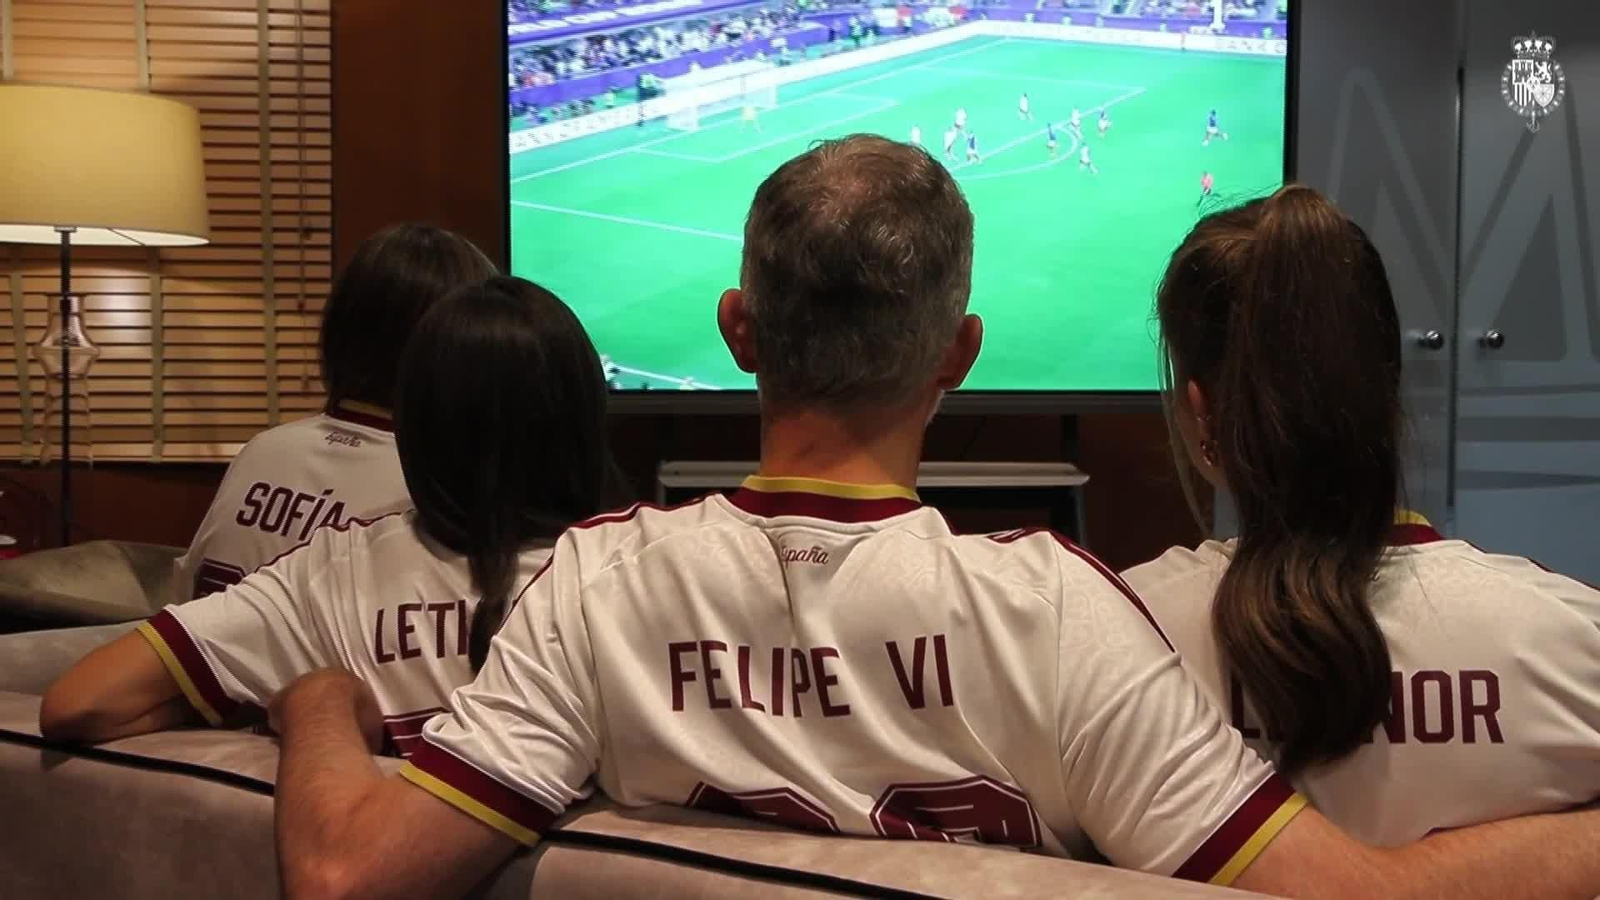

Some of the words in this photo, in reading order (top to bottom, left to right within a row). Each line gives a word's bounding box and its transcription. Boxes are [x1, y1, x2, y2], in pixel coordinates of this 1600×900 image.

[236, 481, 346, 541] SOFÍA
[668, 640, 851, 718] FELIPE
[885, 634, 954, 710] VI
